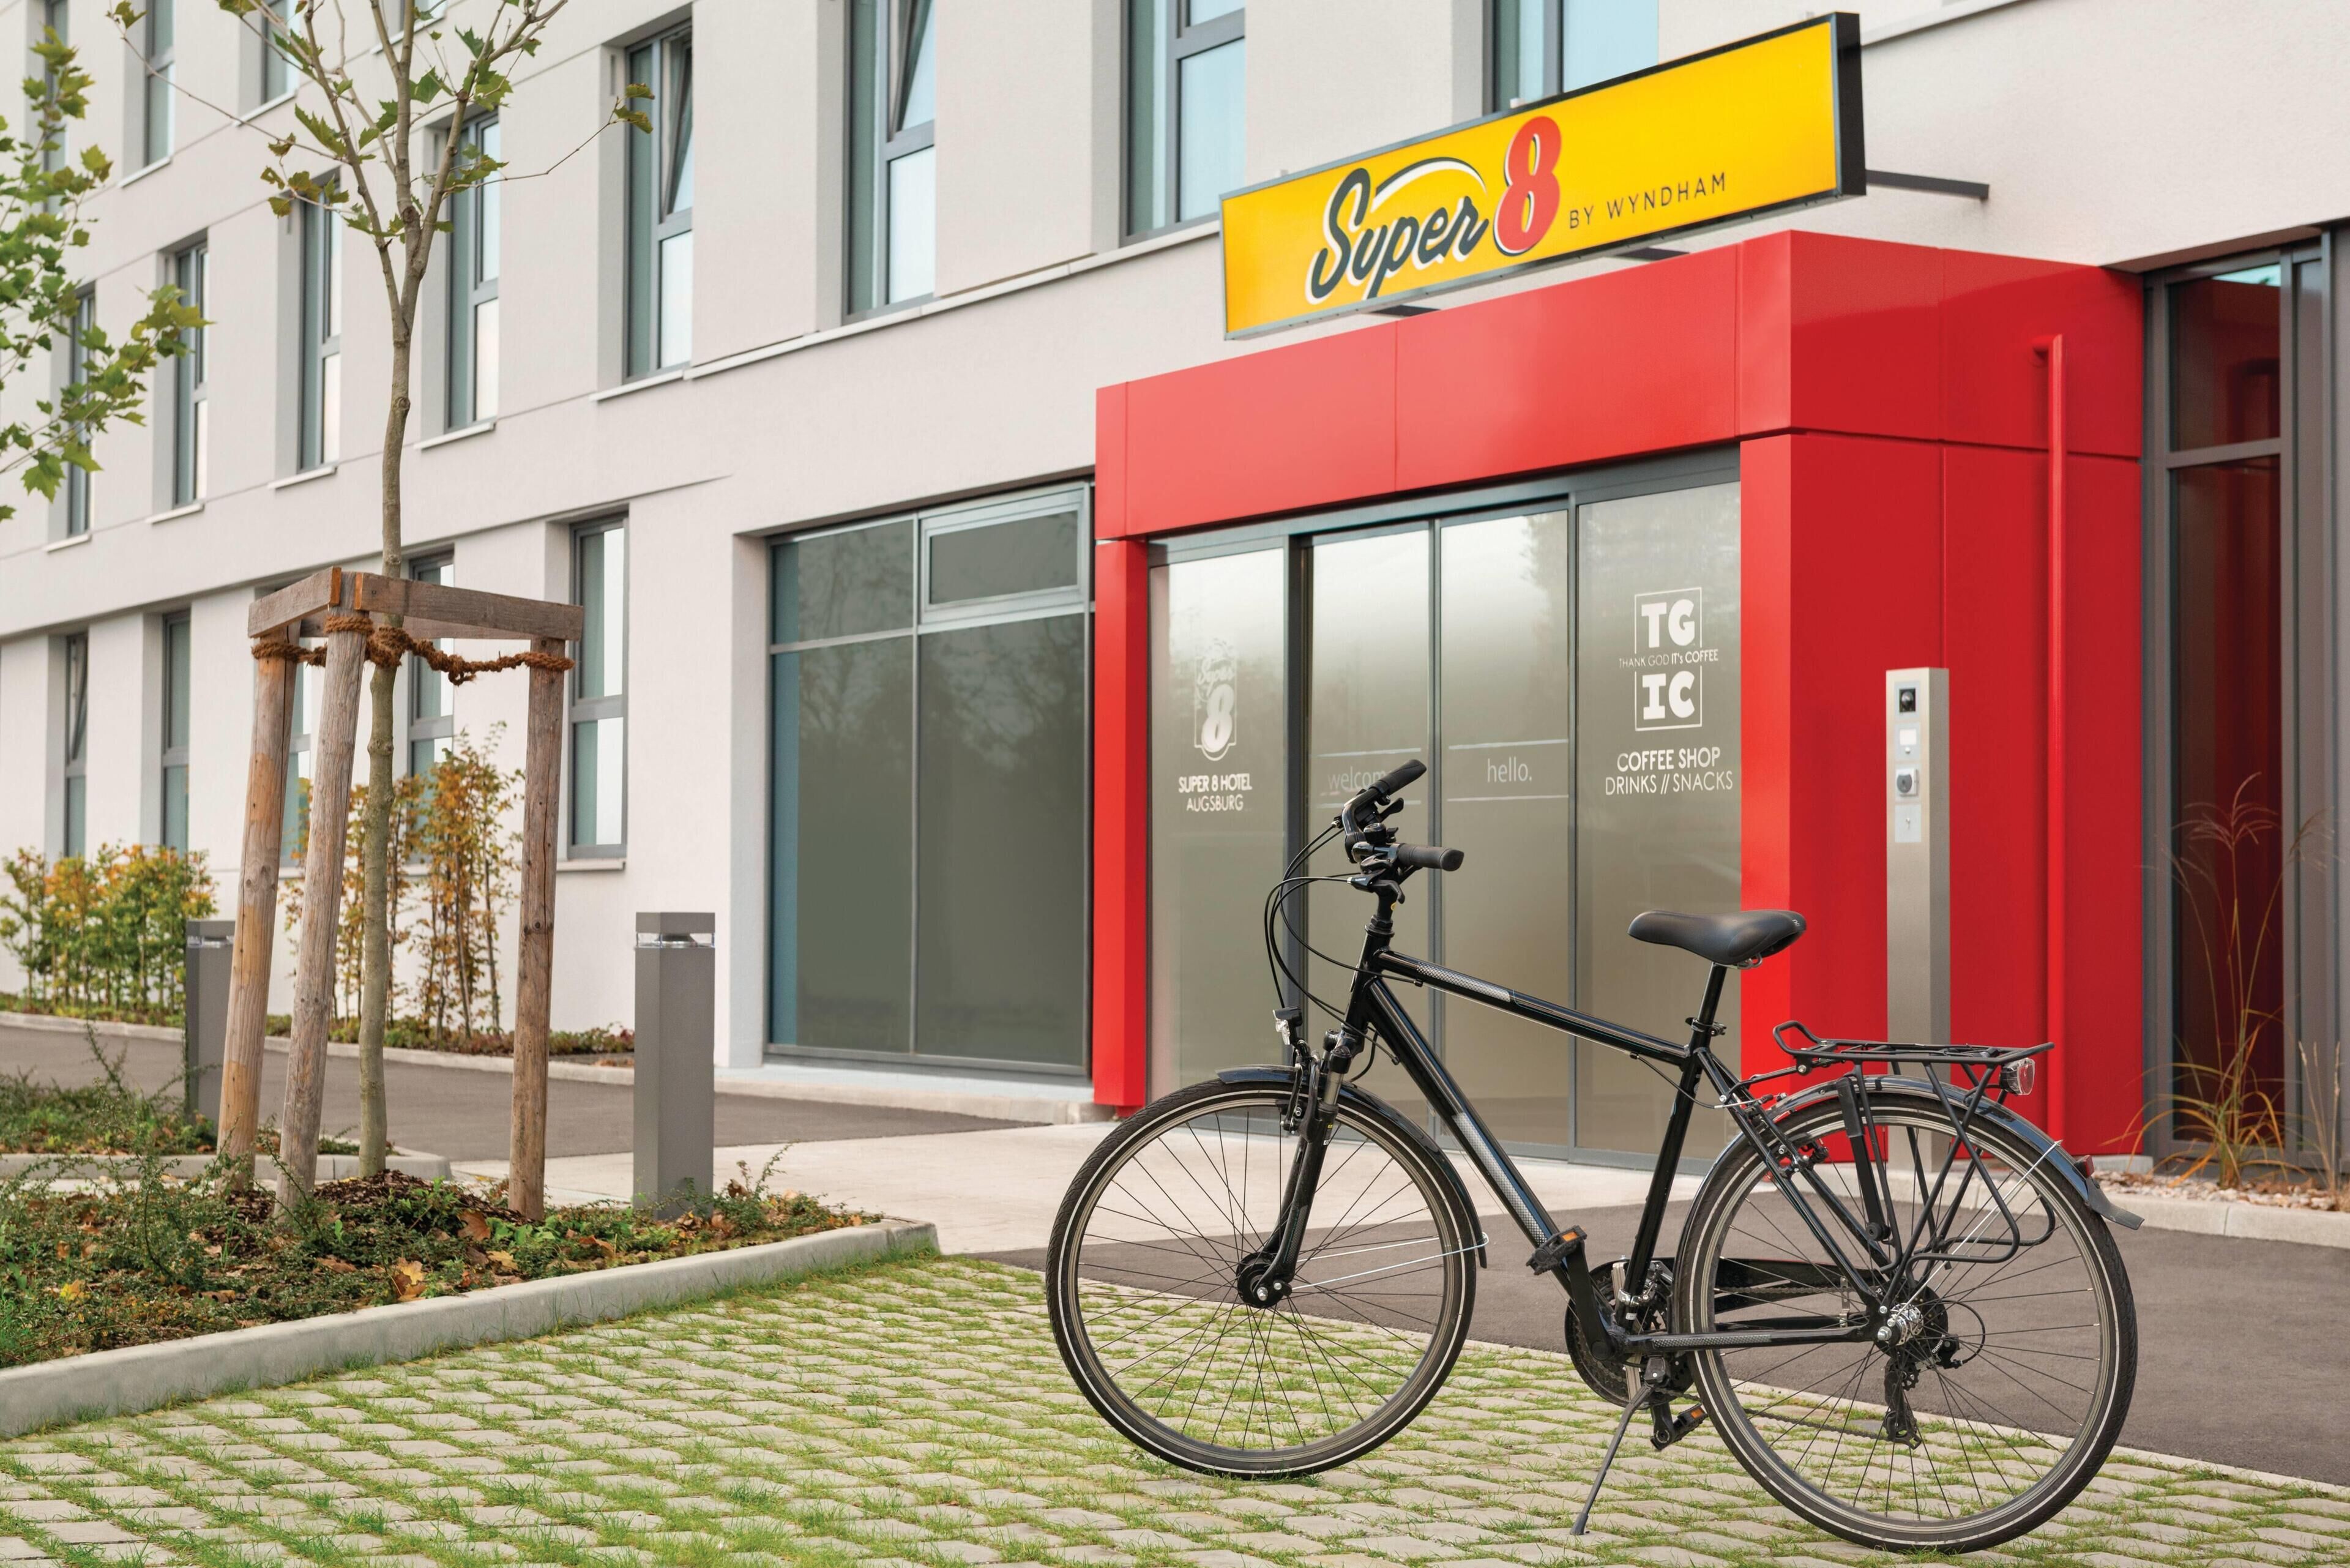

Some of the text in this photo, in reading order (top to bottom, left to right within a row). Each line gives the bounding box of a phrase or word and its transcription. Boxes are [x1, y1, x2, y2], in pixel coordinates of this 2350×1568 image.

[1306, 116, 1725, 301] Super 8 BY WYNDHAM
[1641, 599, 1695, 648] TG
[1619, 657, 1646, 670] THANK
[1648, 654, 1669, 666] GOD
[1685, 649, 1718, 663] COFFEE
[1642, 671, 1695, 720] IC
[1487, 756, 1532, 782] hello.
[1617, 747, 1721, 772] COFFEE SHOP
[1178, 773, 1253, 793] SUPER 8 HOTEL
[1605, 774, 1657, 795] DRINKS
[1673, 771, 1733, 792] SNACKS
[1187, 794, 1244, 812] AUGSBURG
